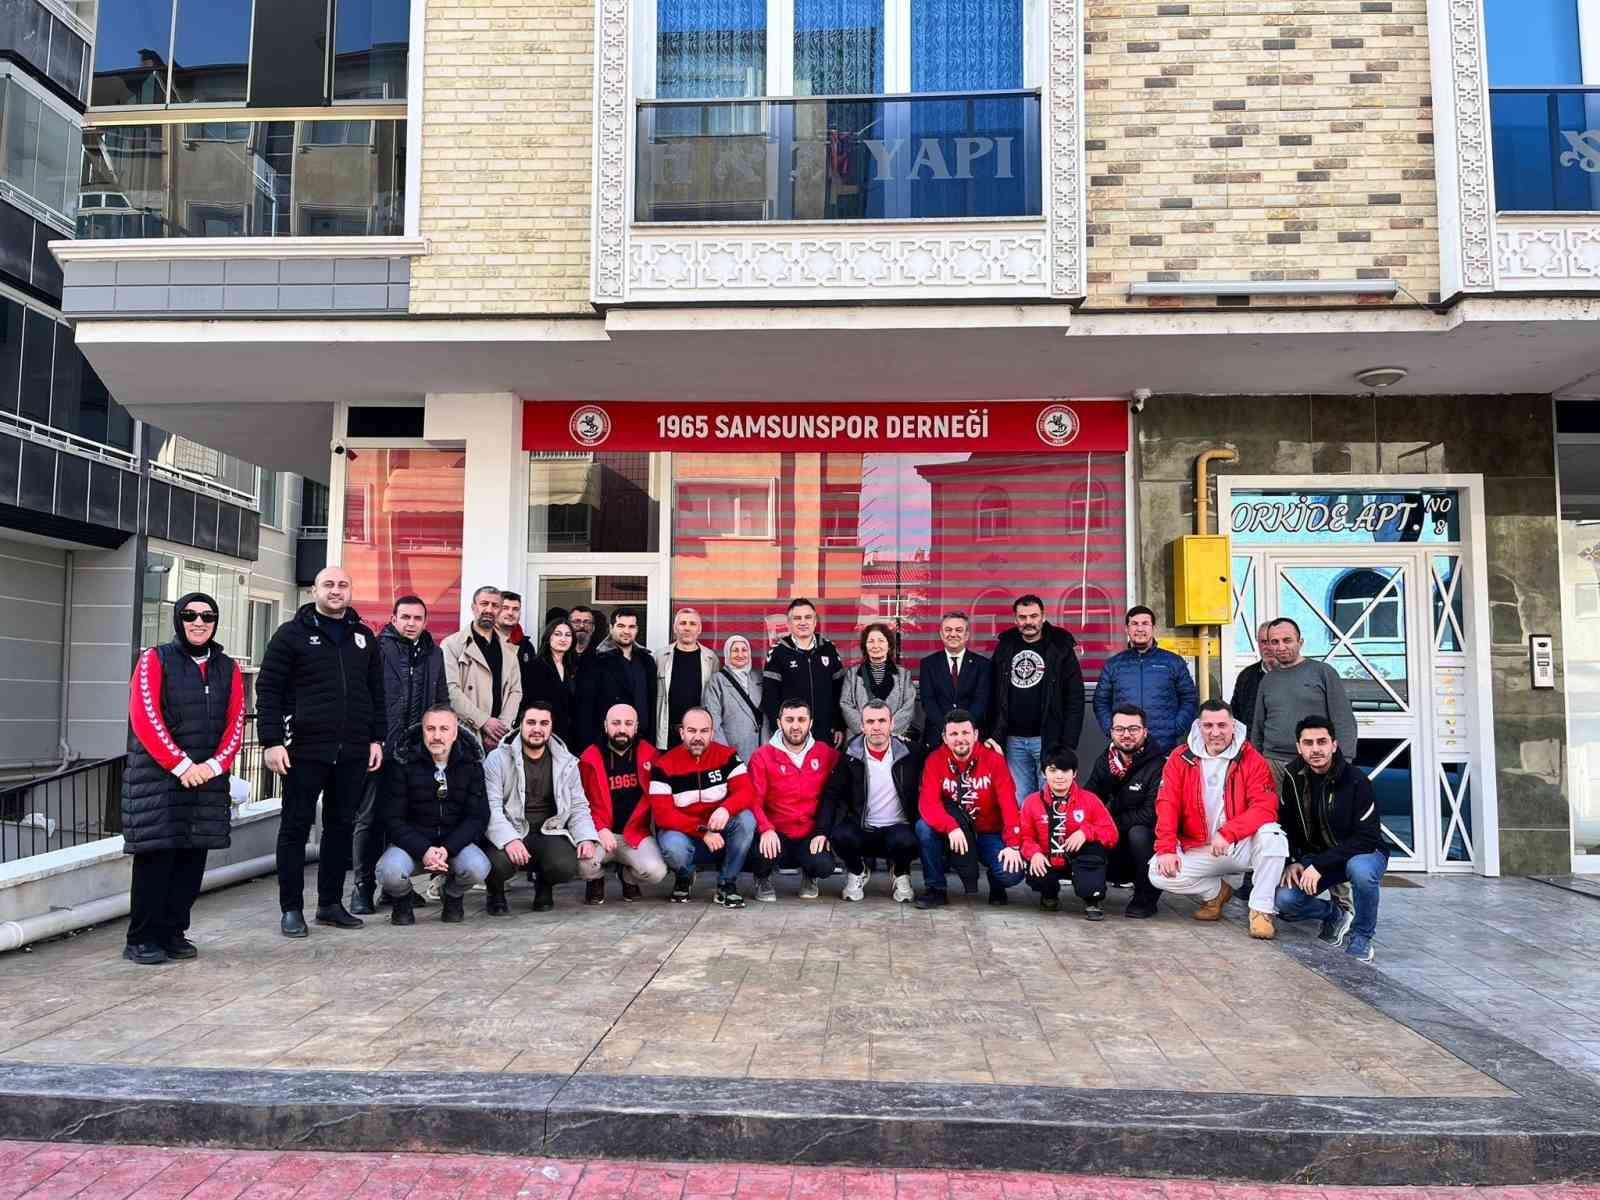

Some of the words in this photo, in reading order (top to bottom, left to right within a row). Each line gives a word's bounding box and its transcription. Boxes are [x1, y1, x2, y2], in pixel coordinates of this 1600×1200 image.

[864, 137, 1015, 181] YAPI
[657, 415, 709, 439] 1965
[715, 414, 879, 439] SAMSUNSPOR
[886, 408, 989, 439] DERNEĞİ
[1434, 518, 1446, 536] 8
[608, 774, 638, 790] 1965
[708, 770, 722, 783] 55
